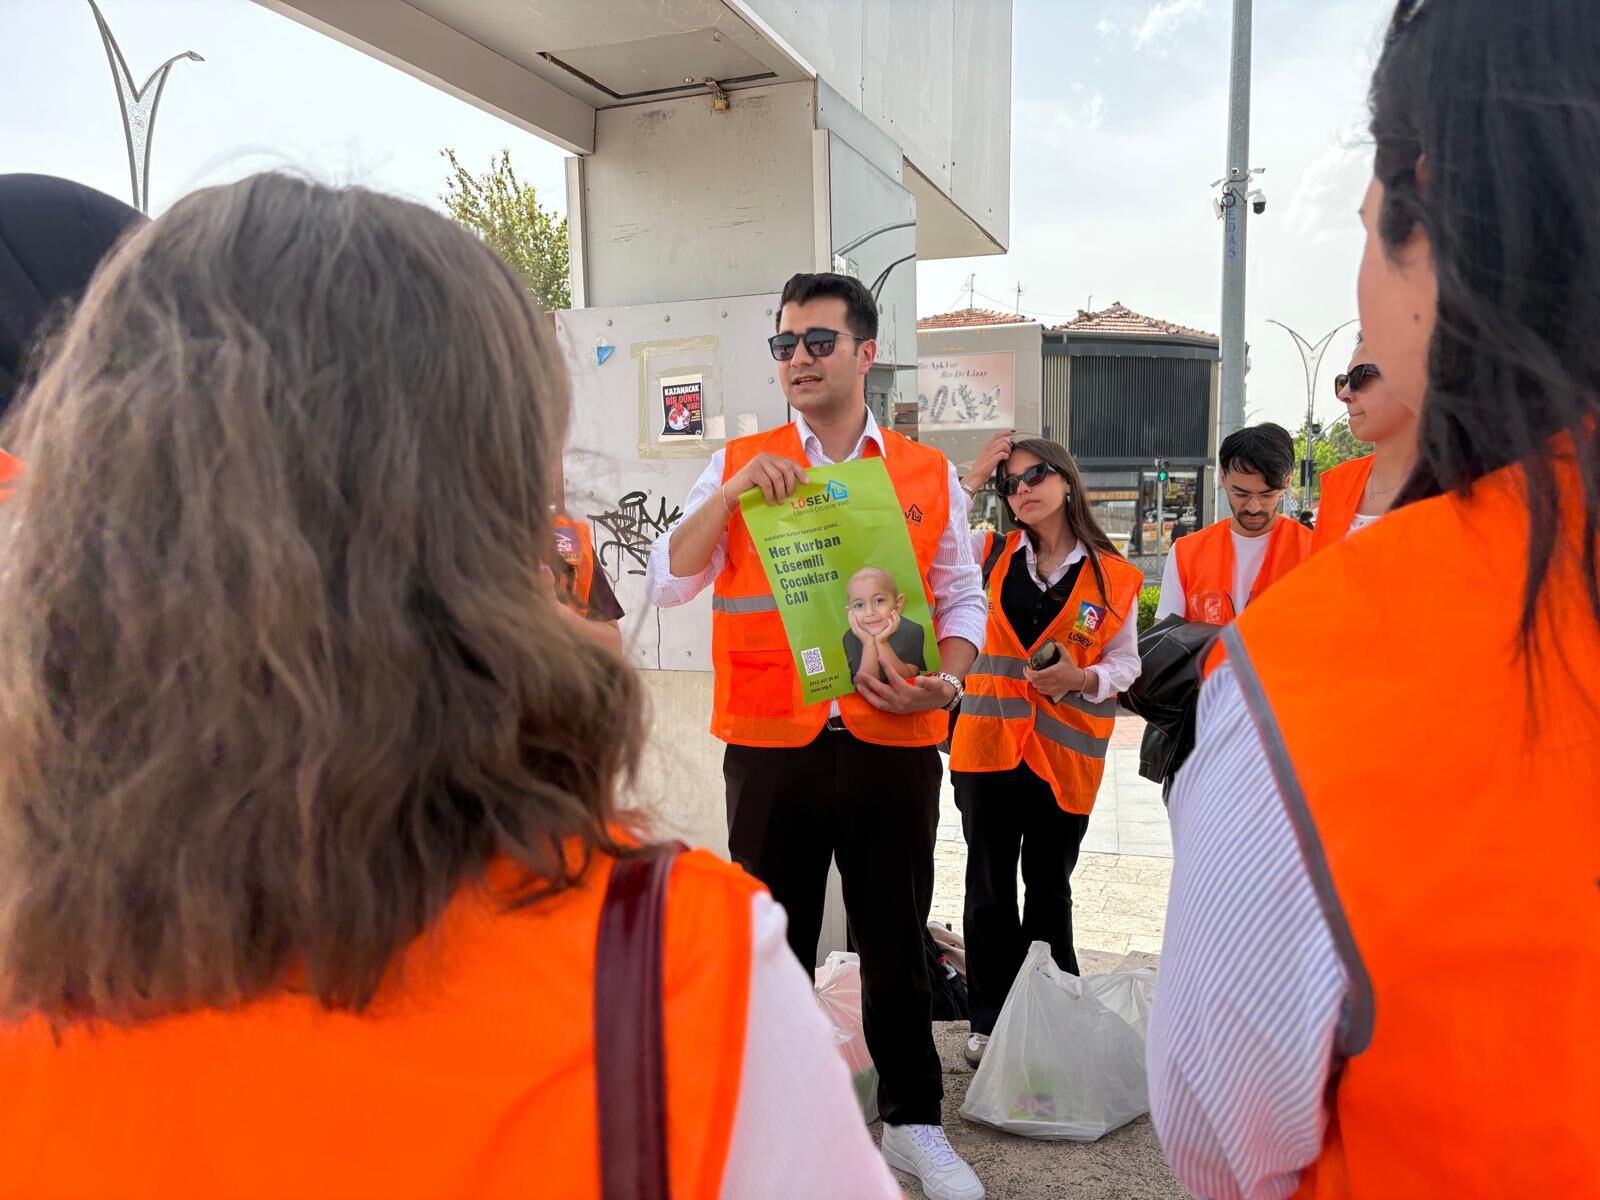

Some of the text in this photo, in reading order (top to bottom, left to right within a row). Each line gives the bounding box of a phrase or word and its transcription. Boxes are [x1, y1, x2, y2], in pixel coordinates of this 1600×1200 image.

[664, 384, 700, 396] KAZANACAK
[791, 493, 831, 510] LÖSEV
[768, 536, 841, 559] Her Kurban
[774, 554, 825, 575] Lösemili
[780, 570, 839, 593] Çocuklara
[784, 590, 809, 605] CAN
